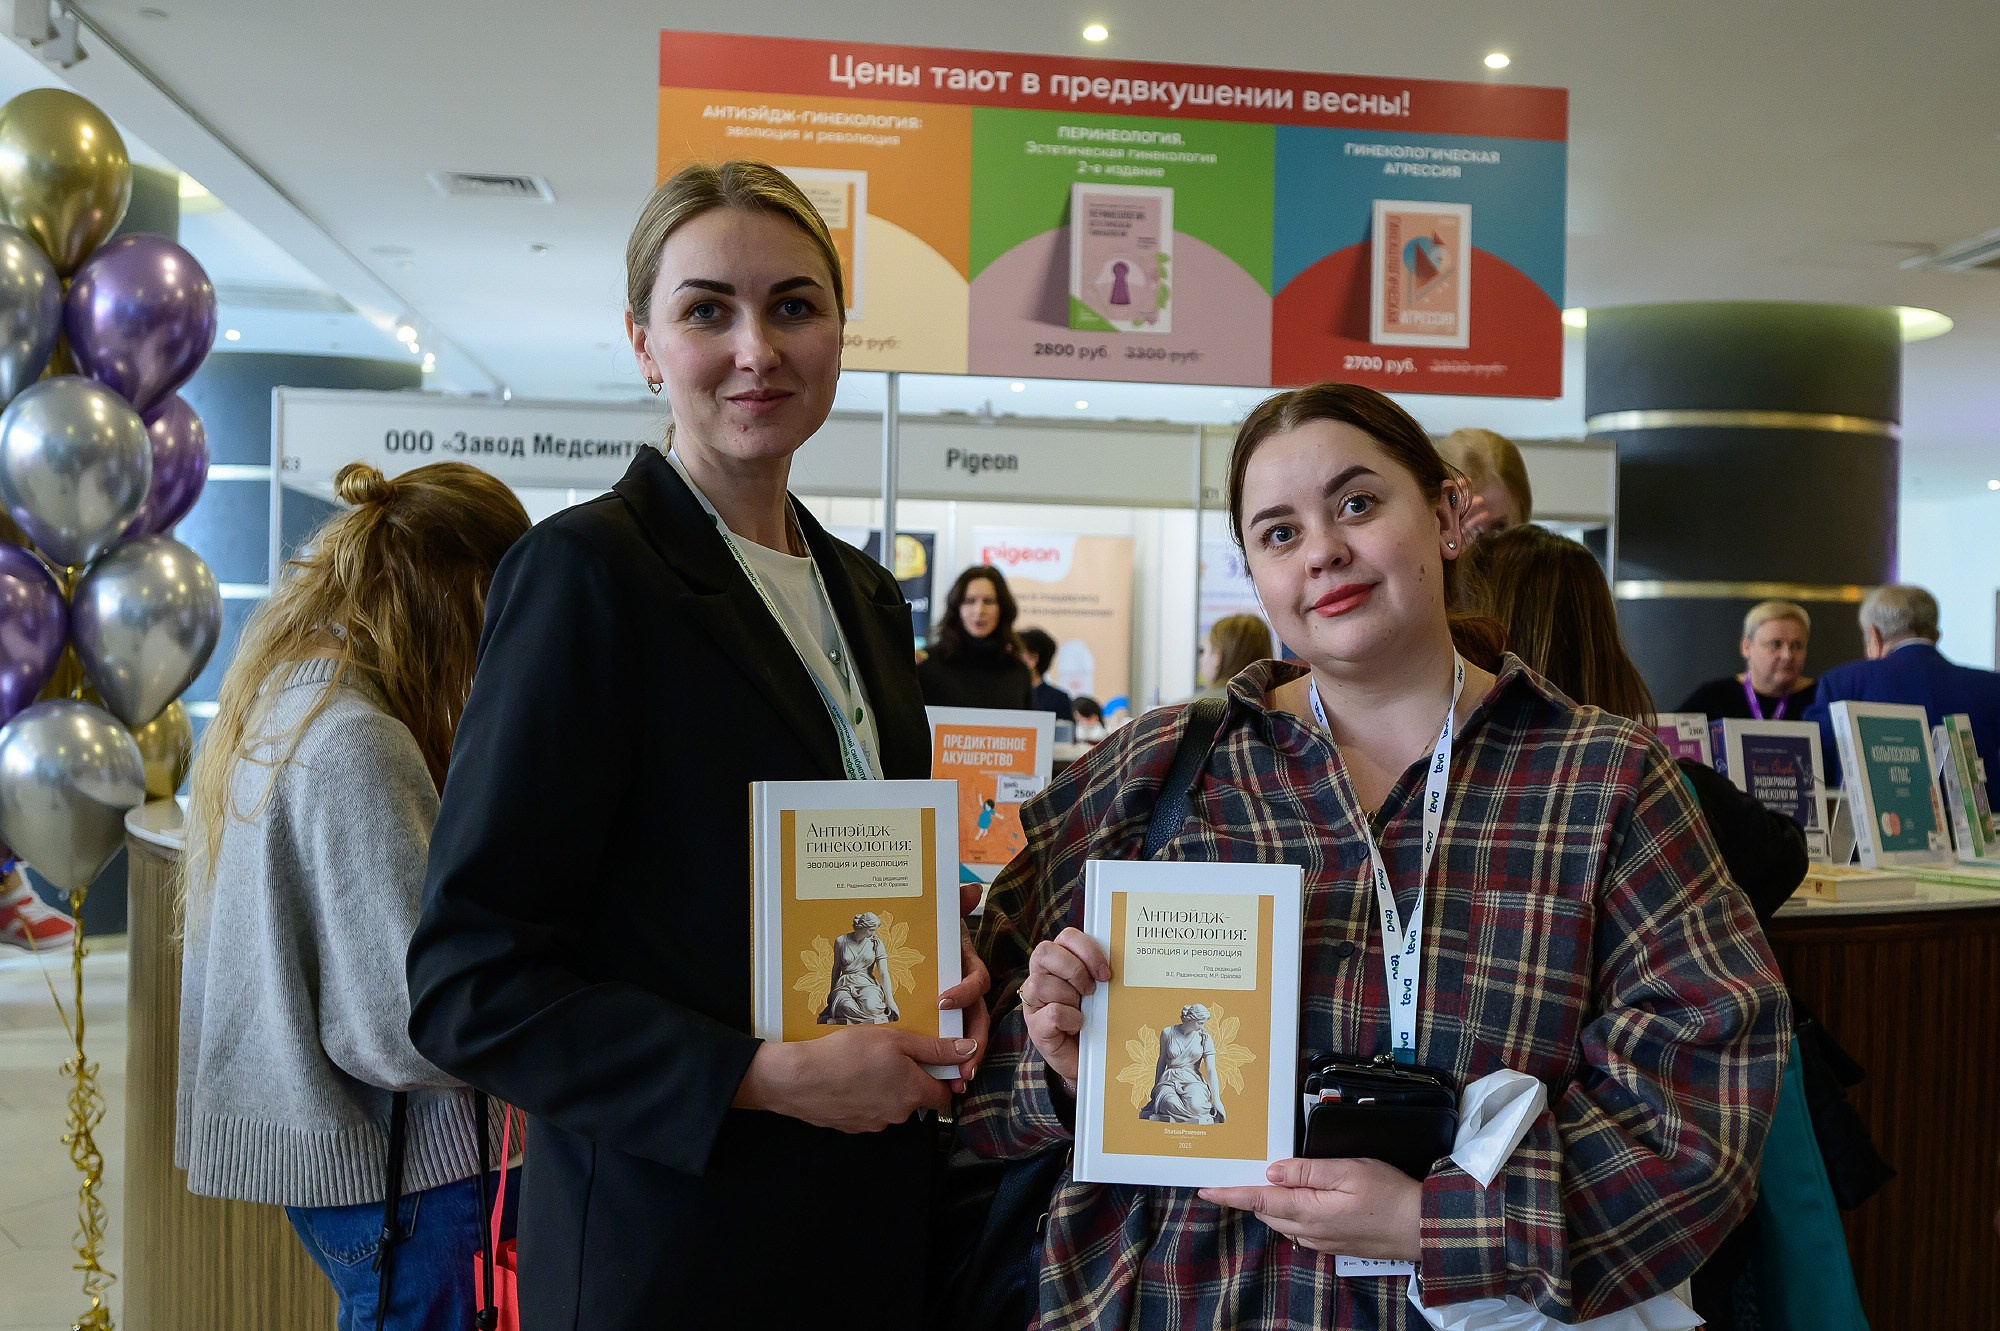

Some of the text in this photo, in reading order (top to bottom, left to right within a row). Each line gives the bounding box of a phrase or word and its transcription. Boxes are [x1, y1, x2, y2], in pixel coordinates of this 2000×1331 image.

[829, 53, 1411, 117] Цены тают в предвкушении весны!
[725, 124, 901, 146] эволюция и революция
[1343, 142, 1501, 164] ГИНЕКОЛОГИЧЕСКАЯ
[1105, 164, 1165, 178] издание
[1383, 162, 1462, 178] АГРЕССИЯ
[1034, 342, 1075, 357] 2800
[1343, 354, 1384, 372] 2700
[385, 429, 433, 454] ООО
[442, 431, 526, 458] «Завод
[945, 448, 1018, 475] Pigeon
[982, 543, 1060, 567] pigeon
[943, 733, 1028, 752] ПРЕДИКТИВНОЕ
[941, 750, 1014, 767] АКУШЕРСТВО
[1433, 752, 1445, 775] teva
[1428, 790, 1440, 814] teva
[806, 822, 897, 839] Антиэйдж-
[806, 839, 912, 854] гинекология:
[1424, 830, 1434, 854] teva
[806, 859, 909, 870] эволюция и революция
[1136, 905, 1231, 925] Антиэйдж-
[1385, 909, 1396, 933] teva
[1136, 924, 1248, 942] гинекология:
[1405, 929, 1417, 956] teva
[1136, 946, 1243, 959] эволюция и революция
[1400, 978, 1413, 1007] teva
